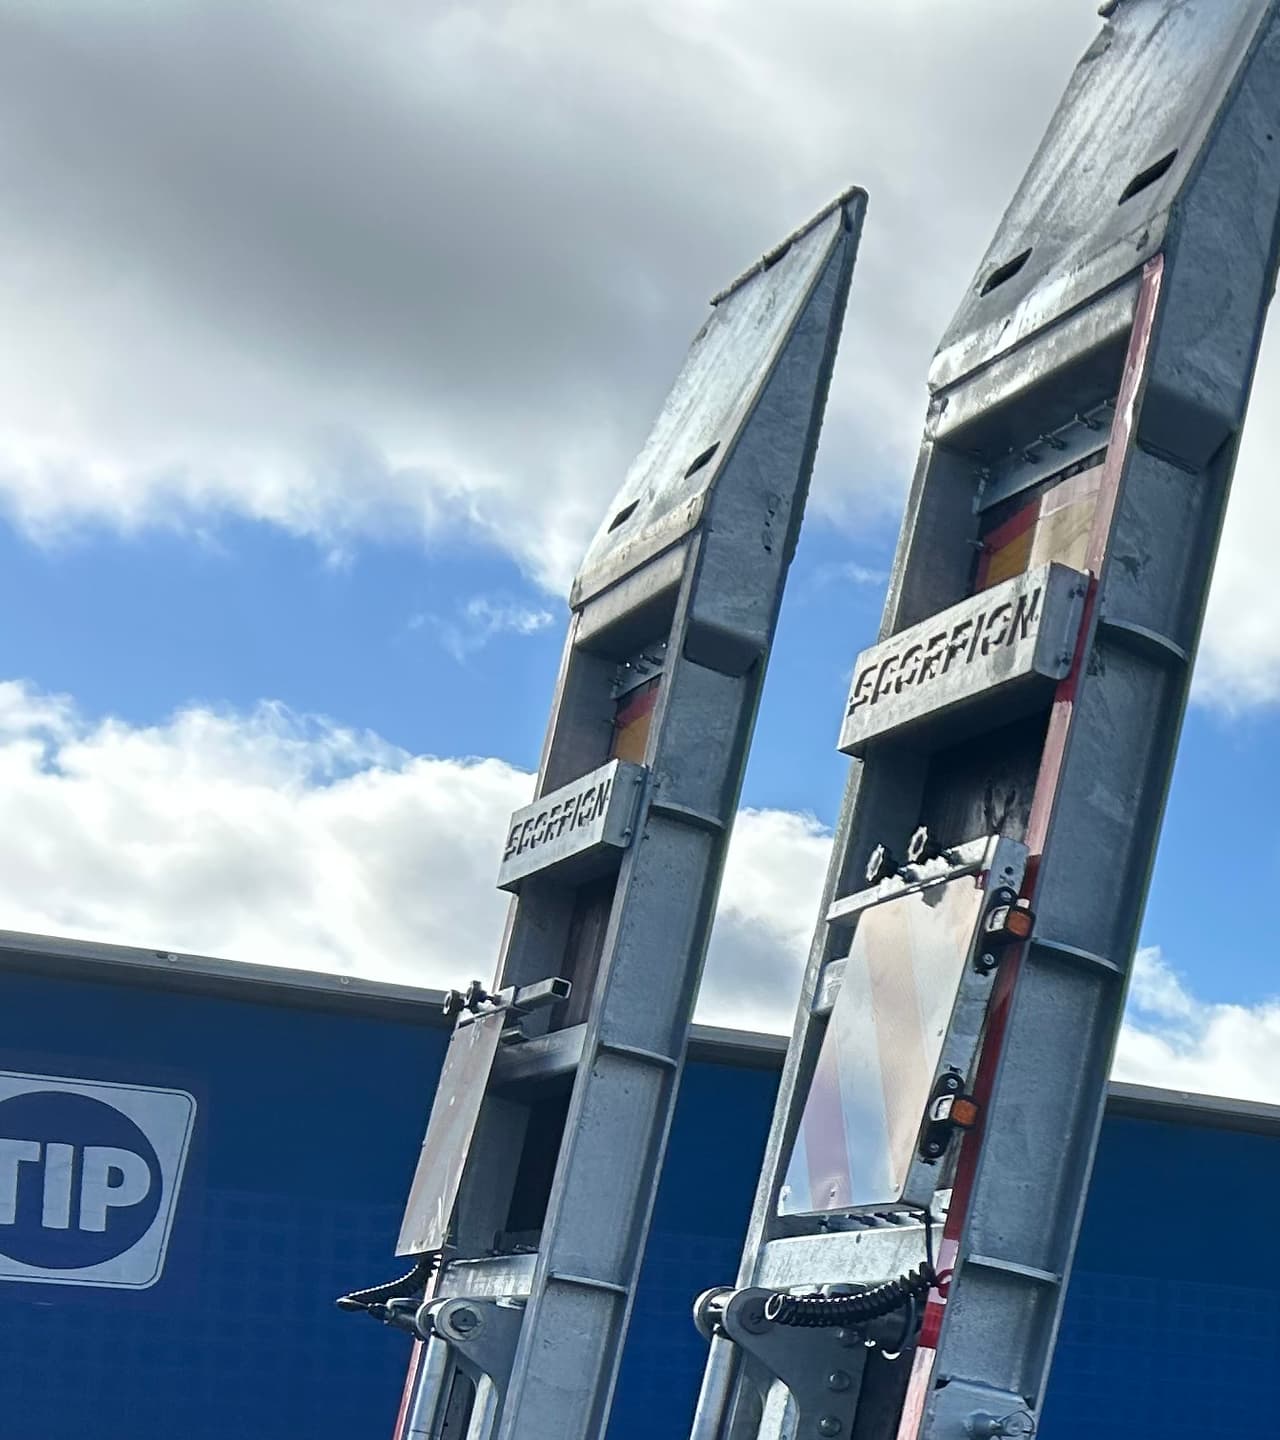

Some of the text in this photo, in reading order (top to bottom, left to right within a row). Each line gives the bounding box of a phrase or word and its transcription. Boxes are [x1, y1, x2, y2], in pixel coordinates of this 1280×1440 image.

[848, 587, 1042, 717] SCORPION
[503, 778, 611, 863] SCORPION
[0, 1138, 151, 1232] TIP
